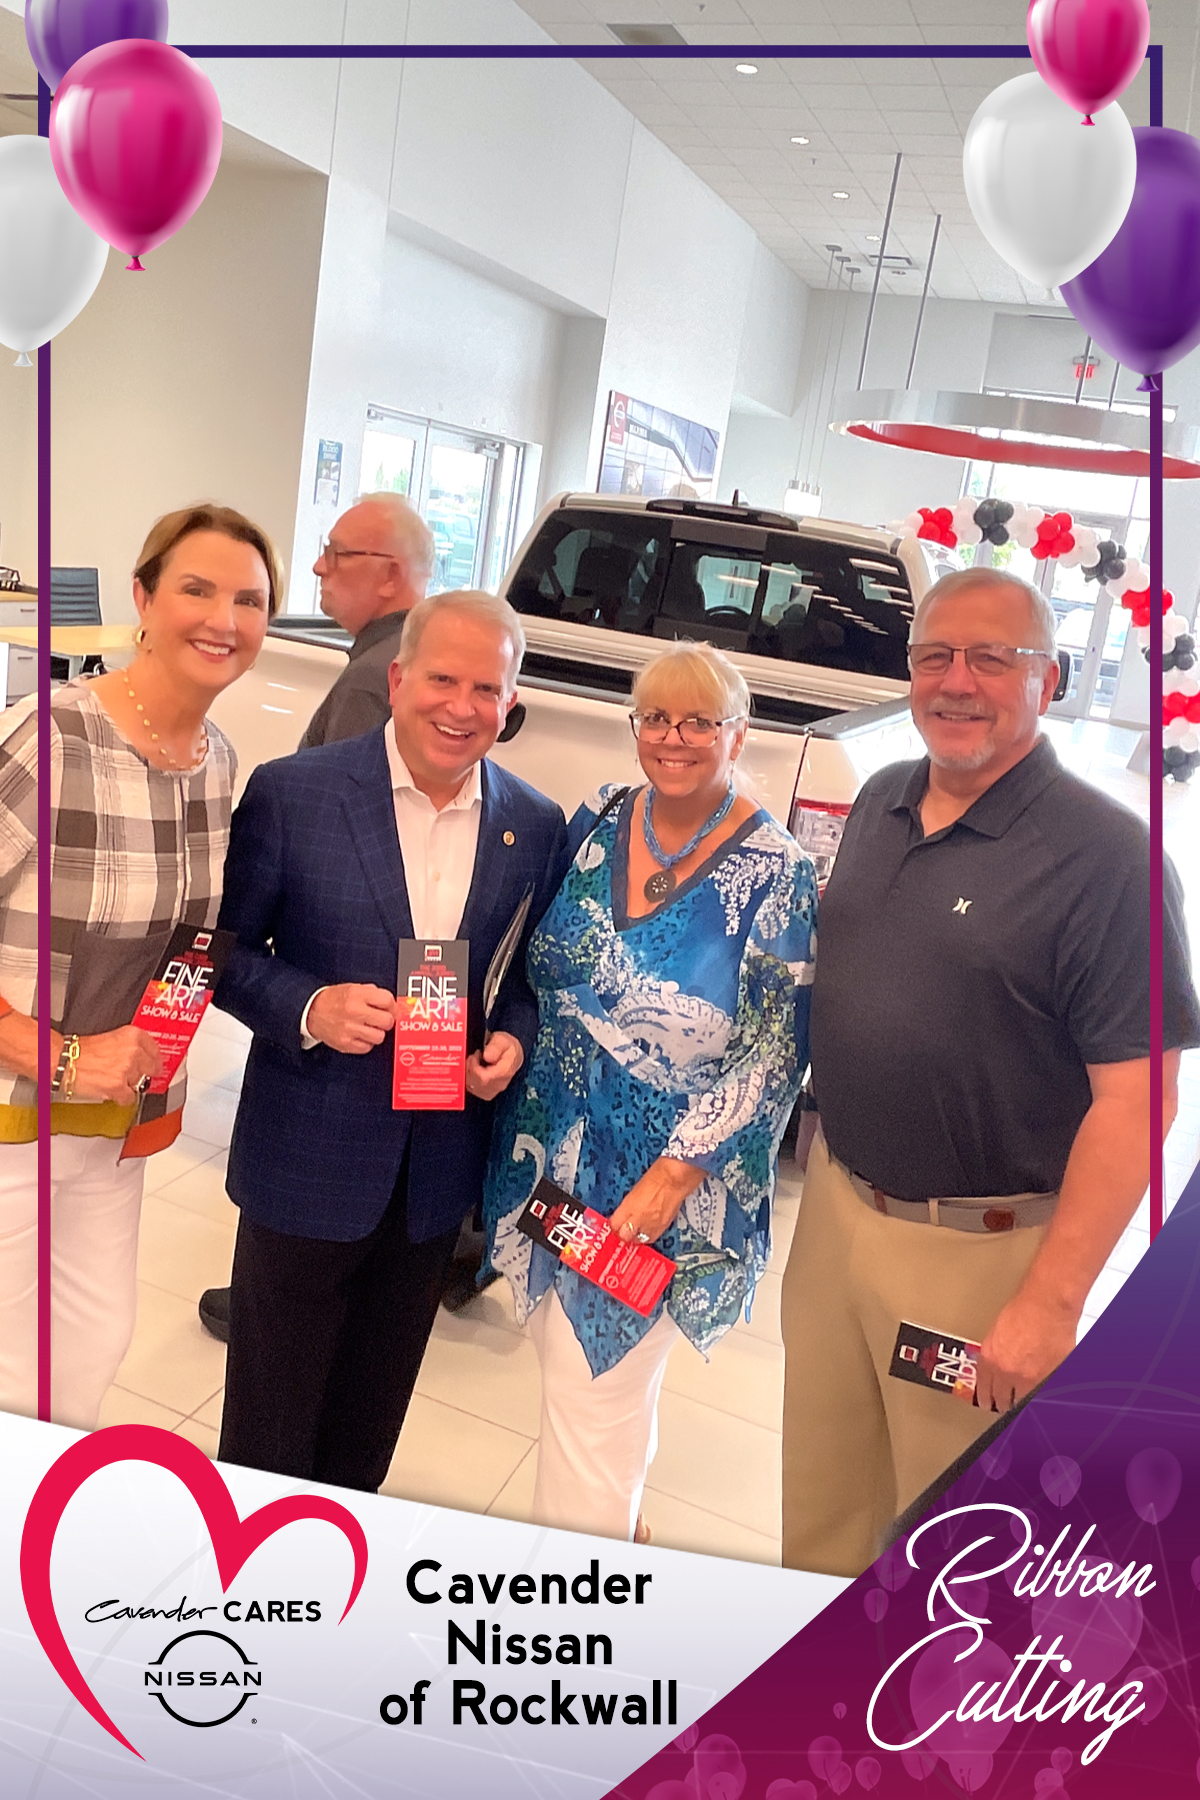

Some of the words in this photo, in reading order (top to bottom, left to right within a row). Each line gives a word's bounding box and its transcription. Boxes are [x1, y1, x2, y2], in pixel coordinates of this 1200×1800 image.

[1076, 363, 1095, 378] EIT
[161, 961, 214, 990] FINE
[155, 984, 204, 1009] ART
[408, 976, 457, 999] FINE
[141, 1005, 171, 1020] SHOW
[178, 1011, 201, 1023] SALE
[410, 998, 451, 1019] ART
[400, 1021, 430, 1031] SHOW
[441, 1022, 463, 1032] SALE
[547, 1204, 583, 1250] FINE
[568, 1216, 596, 1259] ART
[580, 1250, 599, 1273] SHOW
[931, 1343, 963, 1387] FINE
